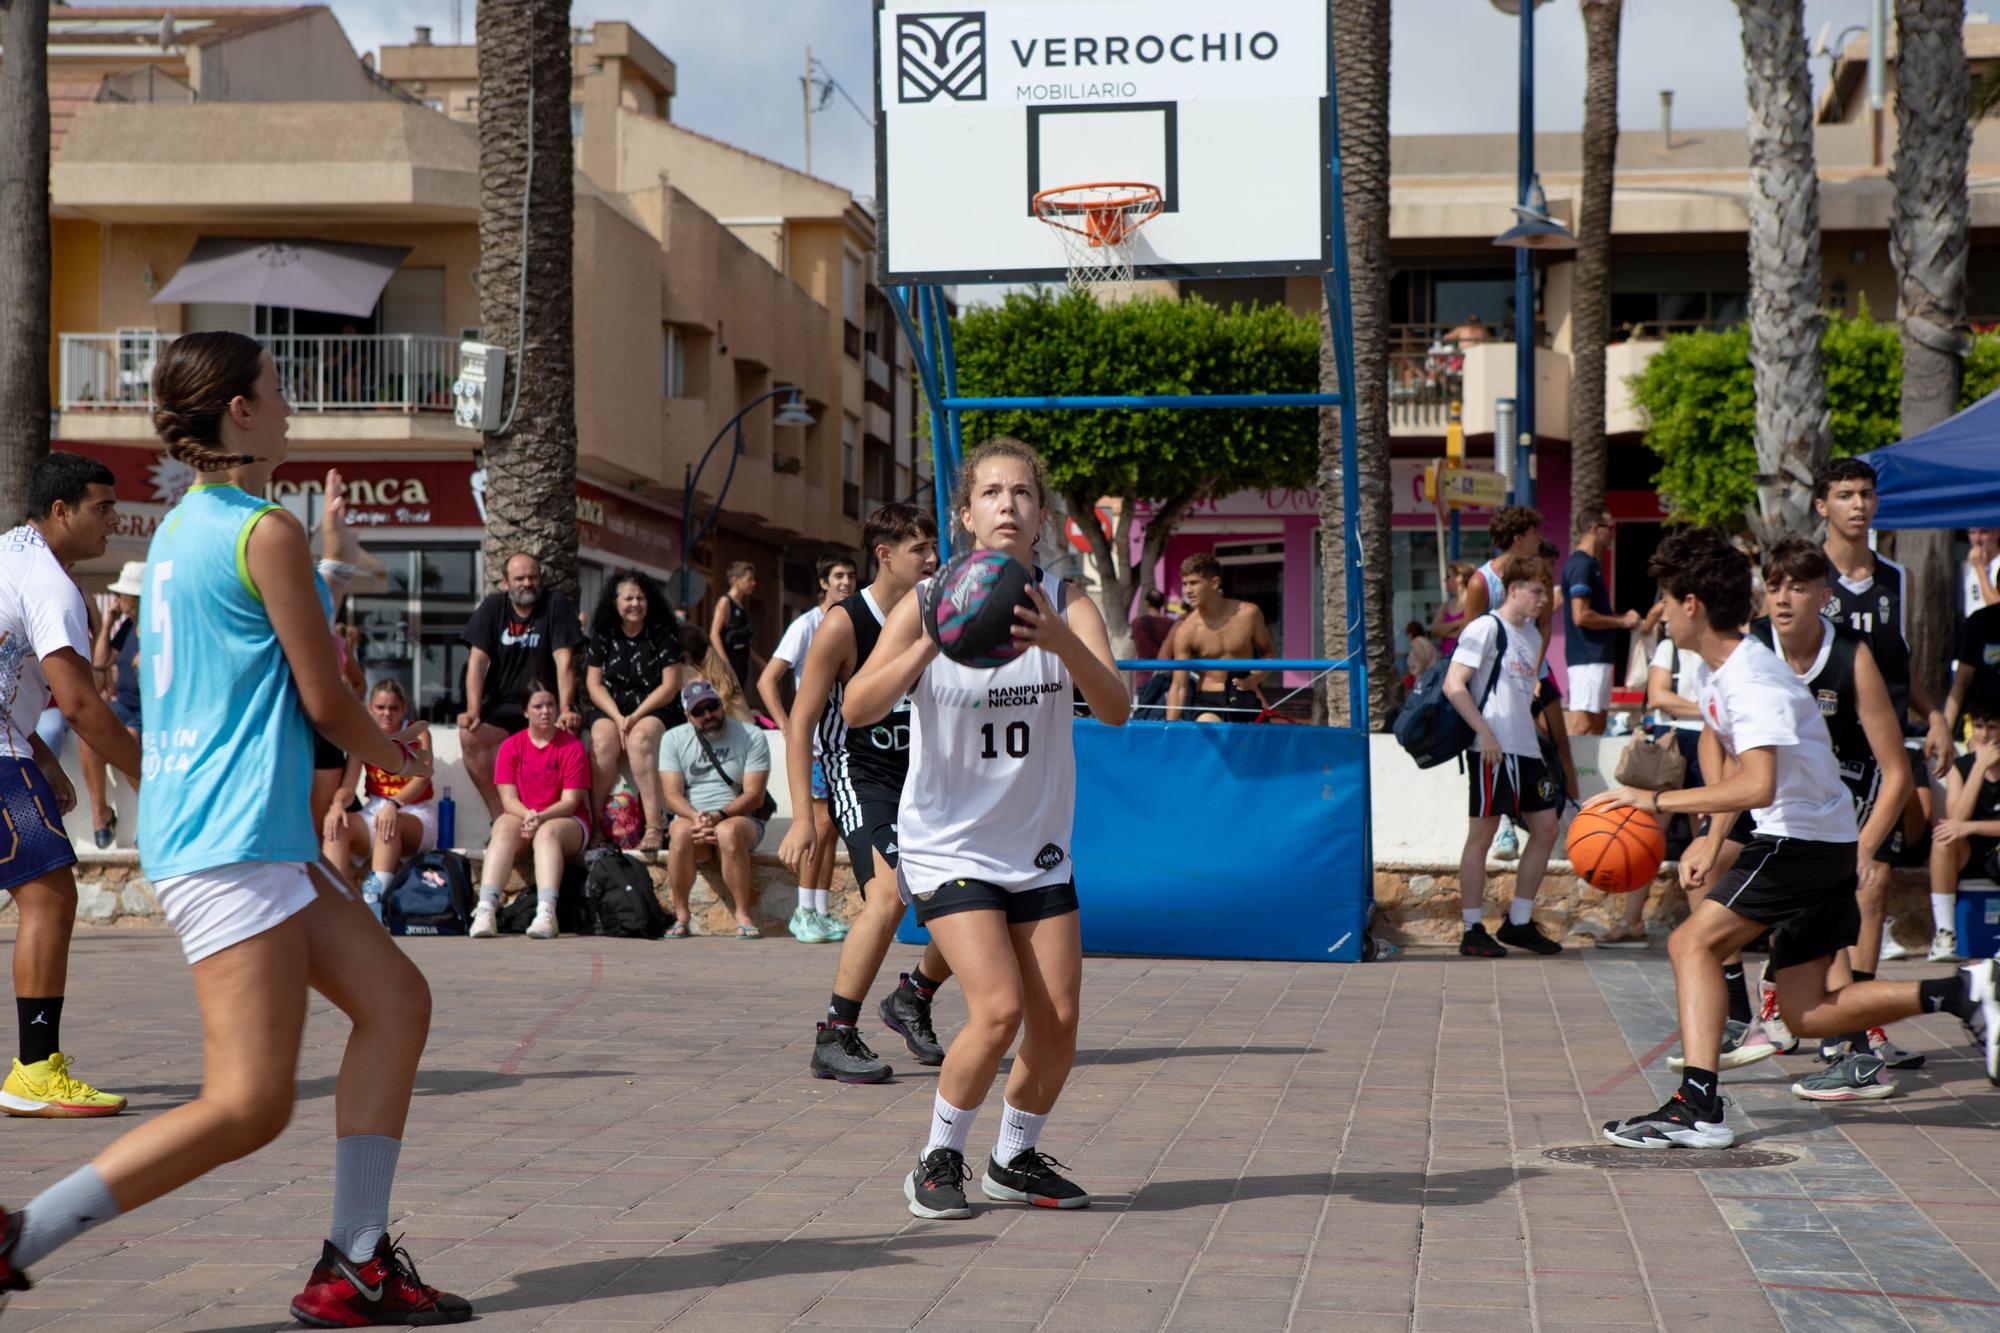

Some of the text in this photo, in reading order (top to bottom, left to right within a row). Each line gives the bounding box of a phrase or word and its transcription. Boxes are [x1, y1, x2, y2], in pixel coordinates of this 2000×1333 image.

[1011, 32, 1279, 67] VERROCHIO
[1016, 82, 1137, 101] MOBILIARIO
[151, 559, 175, 699] 5
[1849, 612, 1873, 634] 11
[988, 695, 1039, 708] NICOLA
[980, 721, 1030, 759] 10
